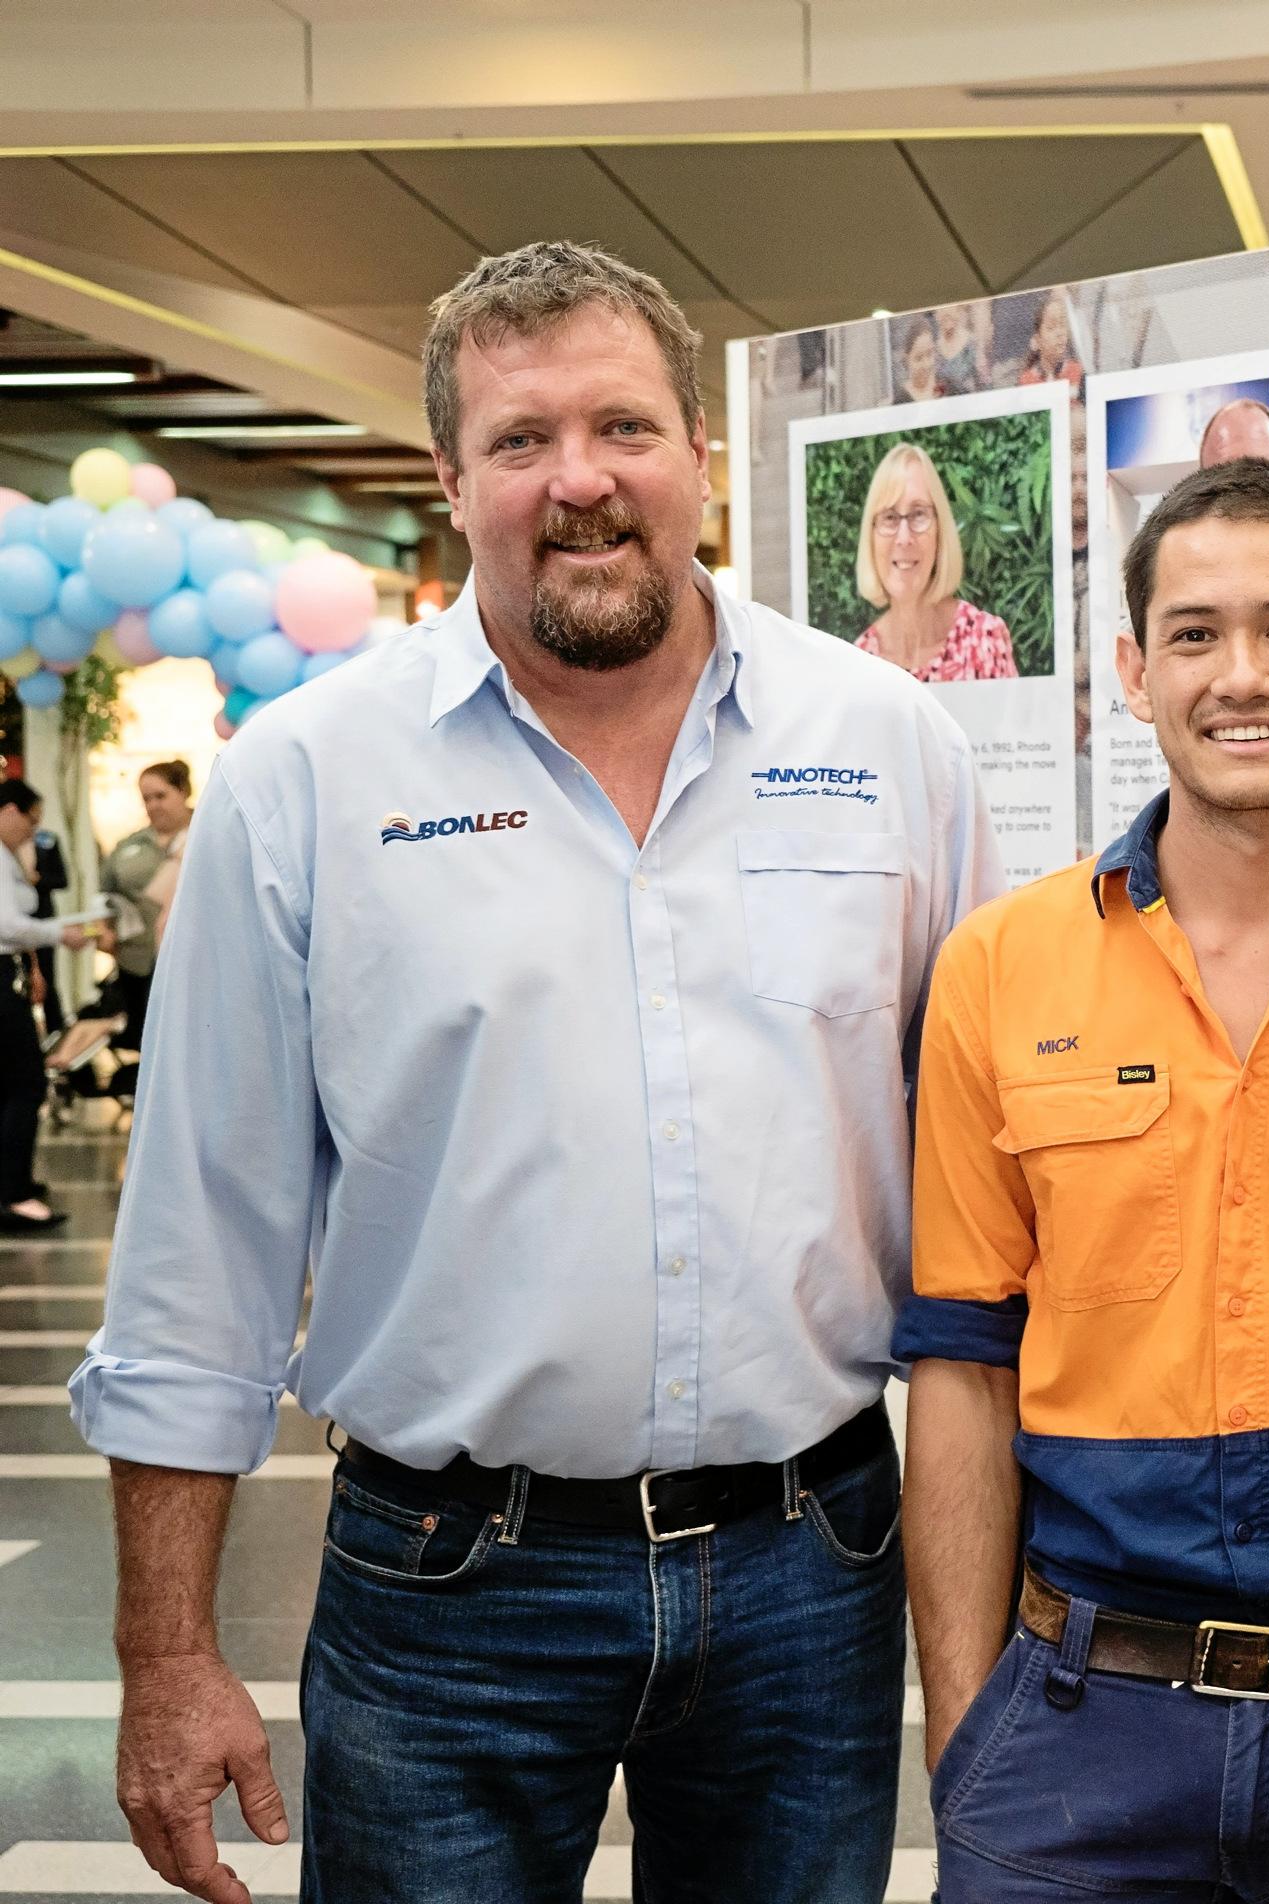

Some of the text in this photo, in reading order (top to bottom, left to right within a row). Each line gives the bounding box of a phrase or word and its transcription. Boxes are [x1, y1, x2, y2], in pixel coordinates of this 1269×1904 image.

[1110, 738, 1152, 749] Born and
[1110, 757, 1152, 769] manages
[1110, 774, 1128, 786] day
[1131, 774, 1157, 785] when
[755, 787, 878, 805] Innovative technology
[418, 810, 528, 840] BONLEC
[1037, 1035, 1079, 1056] MICK
[1122, 1070, 1150, 1080] Bisley
